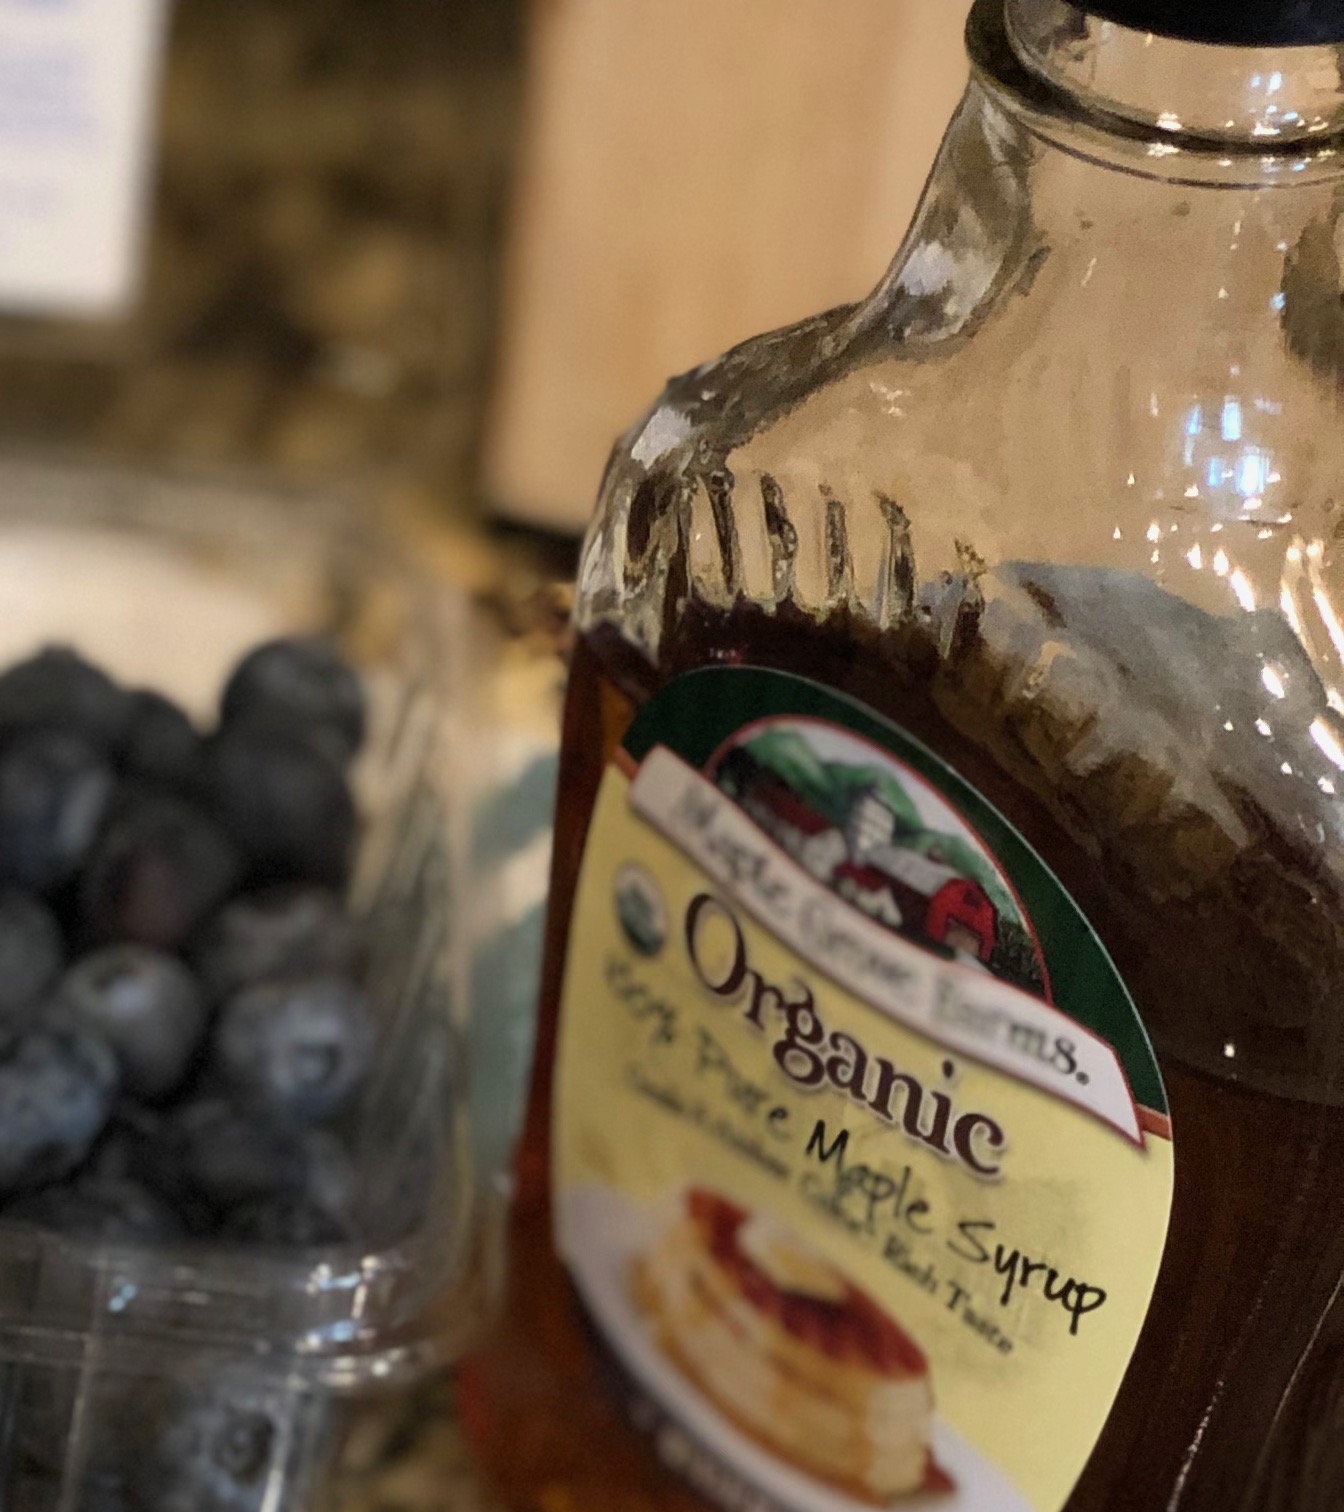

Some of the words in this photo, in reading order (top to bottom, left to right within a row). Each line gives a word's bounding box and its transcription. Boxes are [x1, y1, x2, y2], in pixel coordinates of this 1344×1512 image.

[684, 891, 1005, 1175] Organic
[805, 1119, 934, 1236] Maple
[946, 1219, 1108, 1336] Syrup
